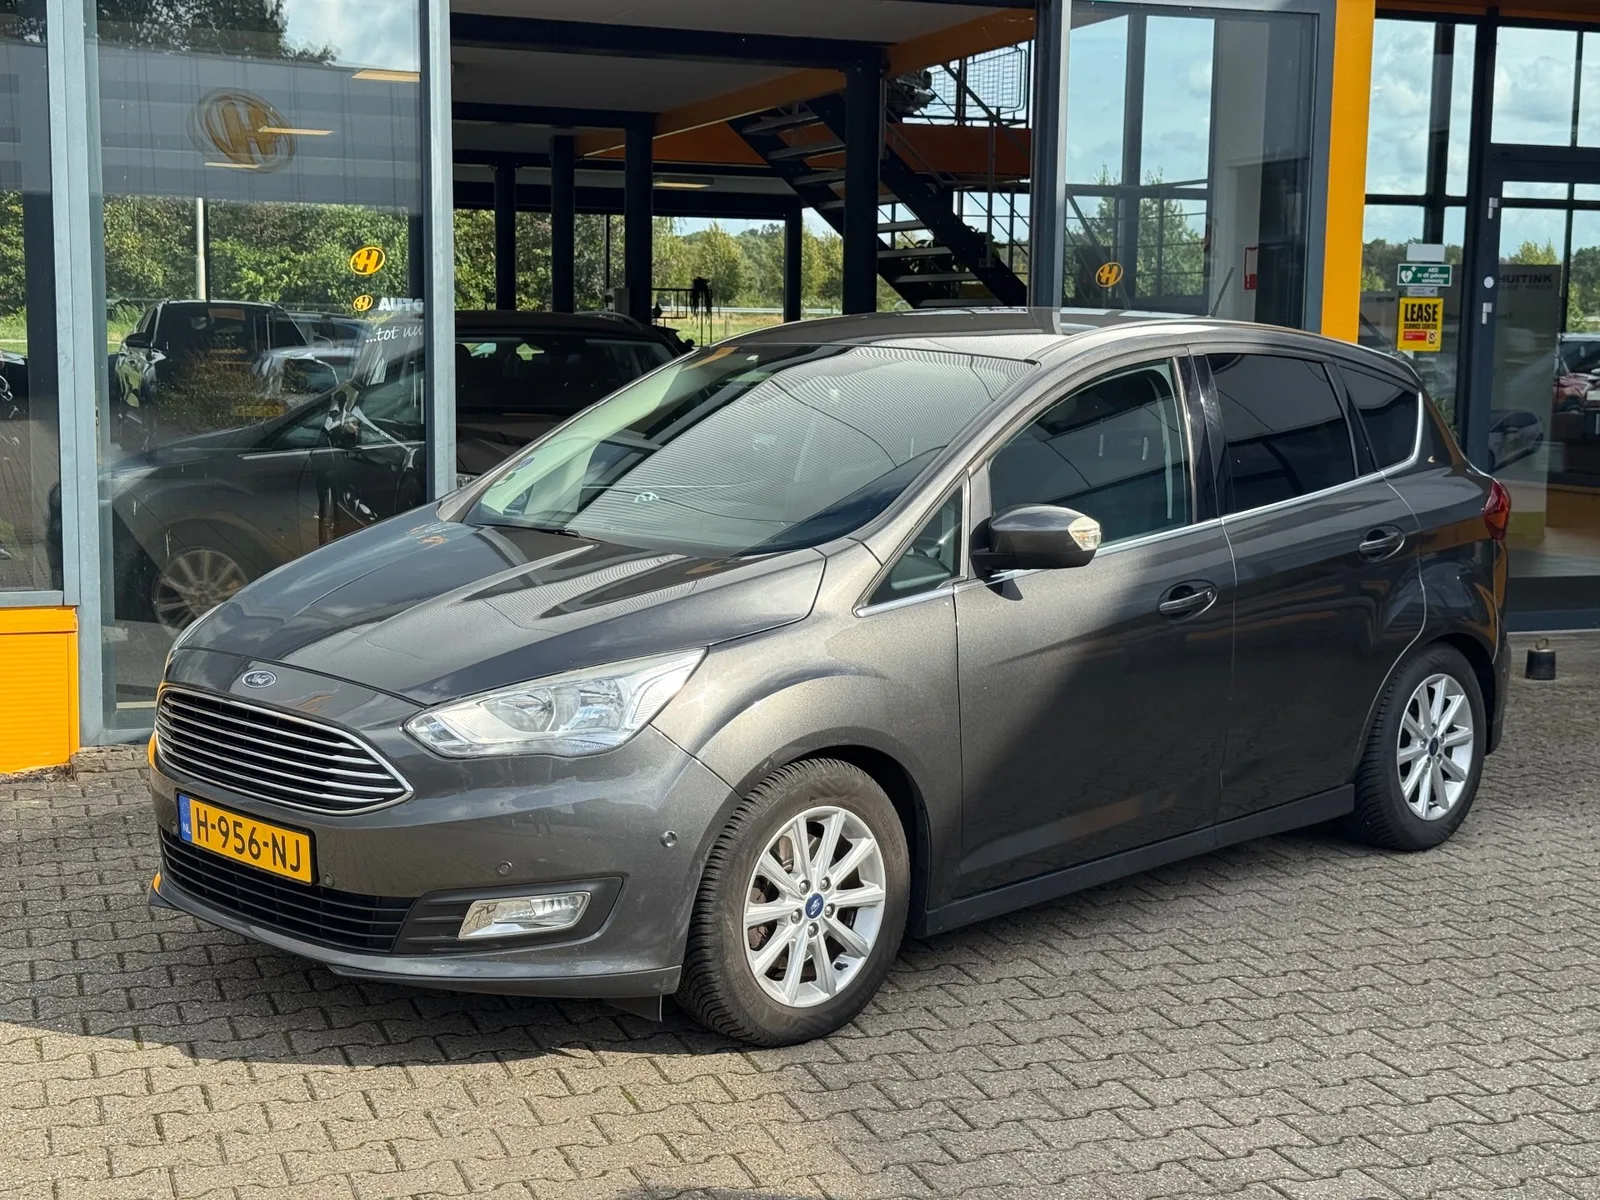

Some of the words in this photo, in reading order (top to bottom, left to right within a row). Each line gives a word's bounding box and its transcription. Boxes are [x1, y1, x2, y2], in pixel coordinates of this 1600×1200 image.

[378, 297, 424, 312] AUTO
[1404, 303, 1438, 323] LEASE
[182, 822, 191, 834] NL
[195, 806, 302, 874] H-956-NJ
